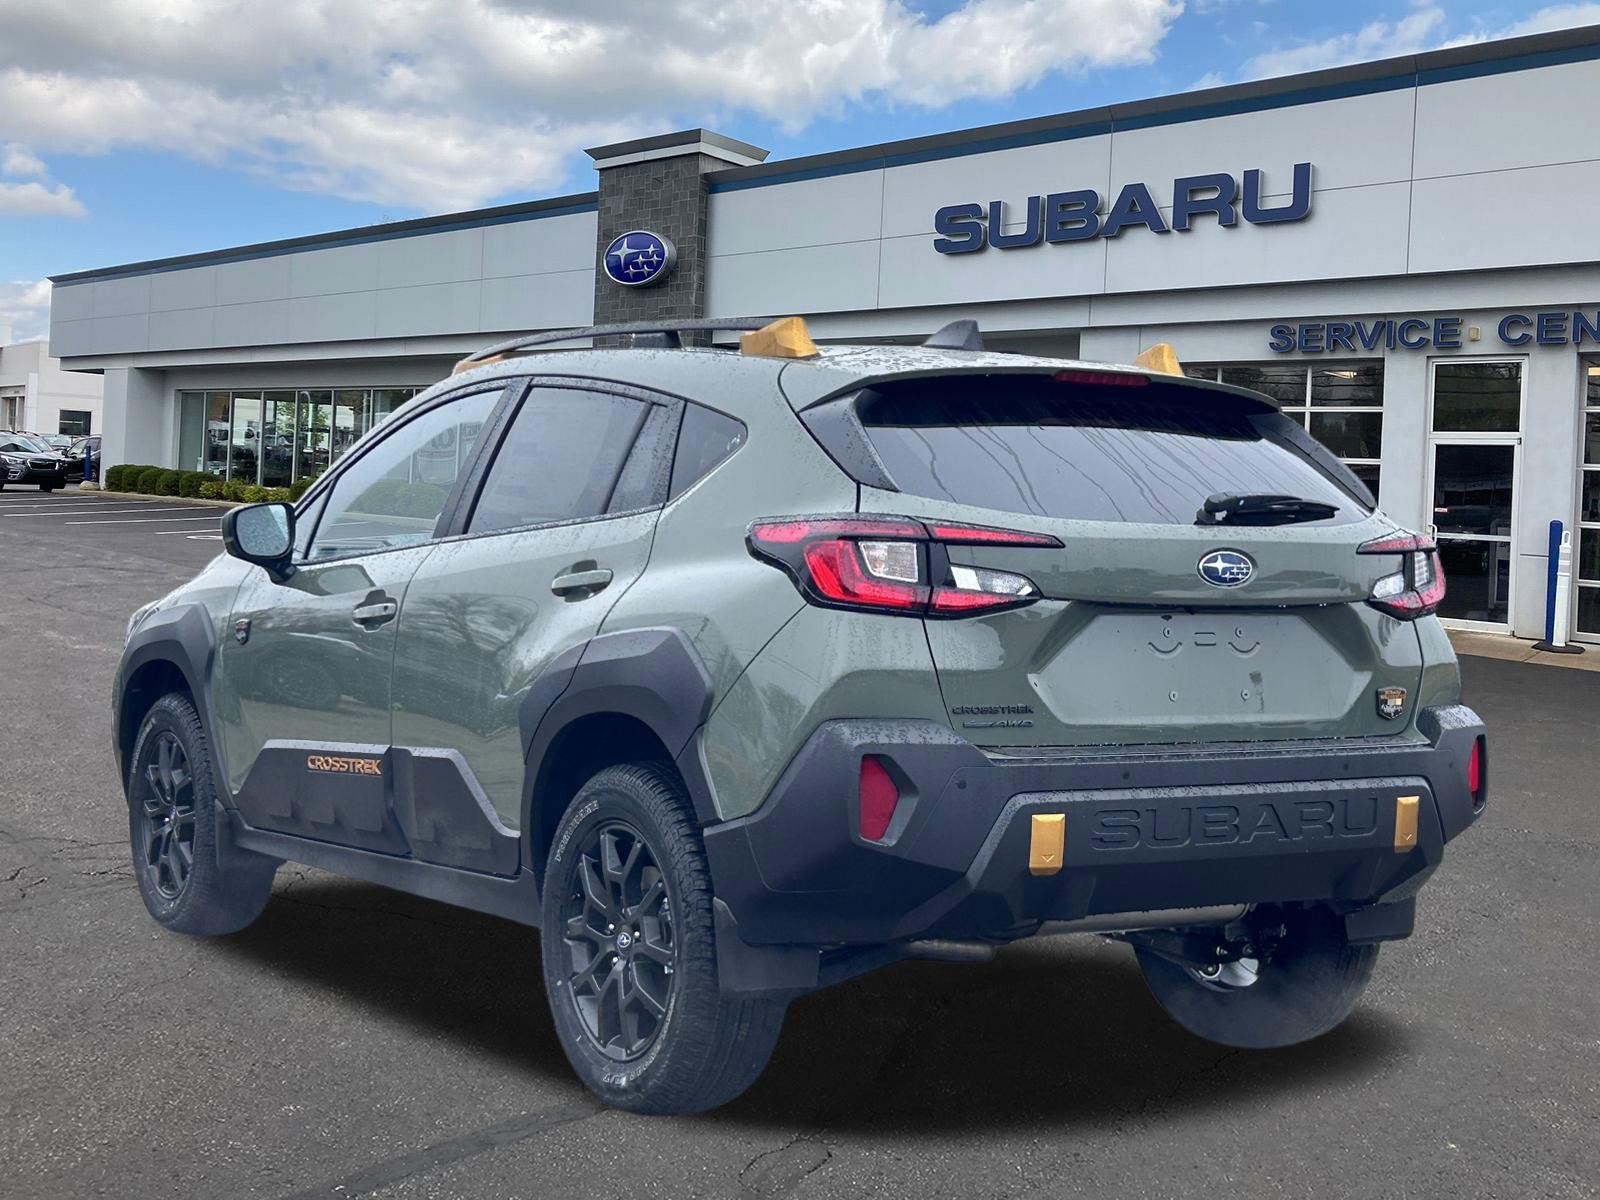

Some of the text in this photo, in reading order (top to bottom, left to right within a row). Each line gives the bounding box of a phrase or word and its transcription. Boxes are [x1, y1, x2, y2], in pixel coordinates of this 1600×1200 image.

[933, 162, 1313, 255] SUBARU
[1269, 318, 1463, 352] SERVICE
[952, 705, 1034, 715] CROSSTREK
[307, 755, 382, 775] CROSSTREK
[1091, 798, 1378, 850] SUBARU
